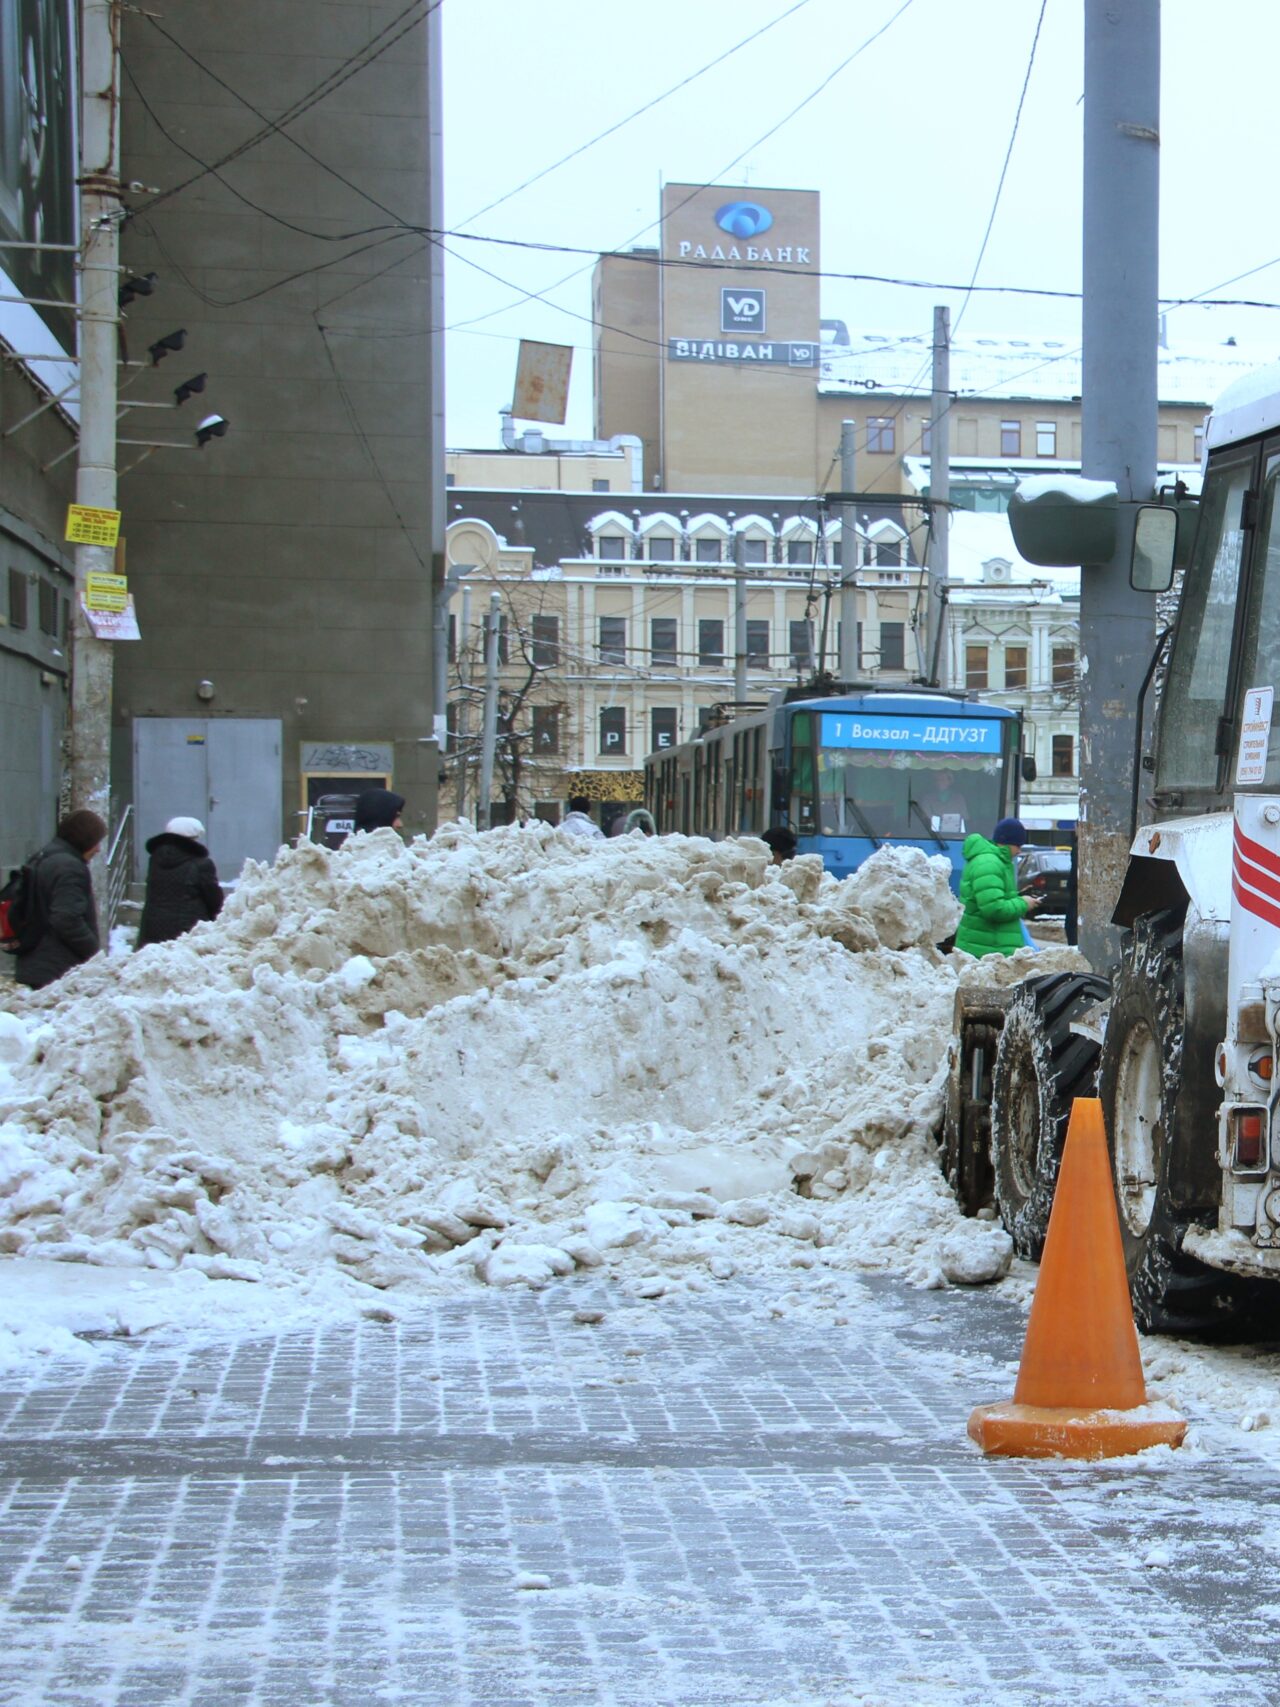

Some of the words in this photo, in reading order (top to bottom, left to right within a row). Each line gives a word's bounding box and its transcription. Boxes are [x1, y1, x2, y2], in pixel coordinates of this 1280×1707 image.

[679, 241, 811, 264] РАДАБАНК
[676, 341, 773, 360] ВІДІВАН
[835, 723, 842, 737] 1
[852, 723, 909, 740] Вокзал
